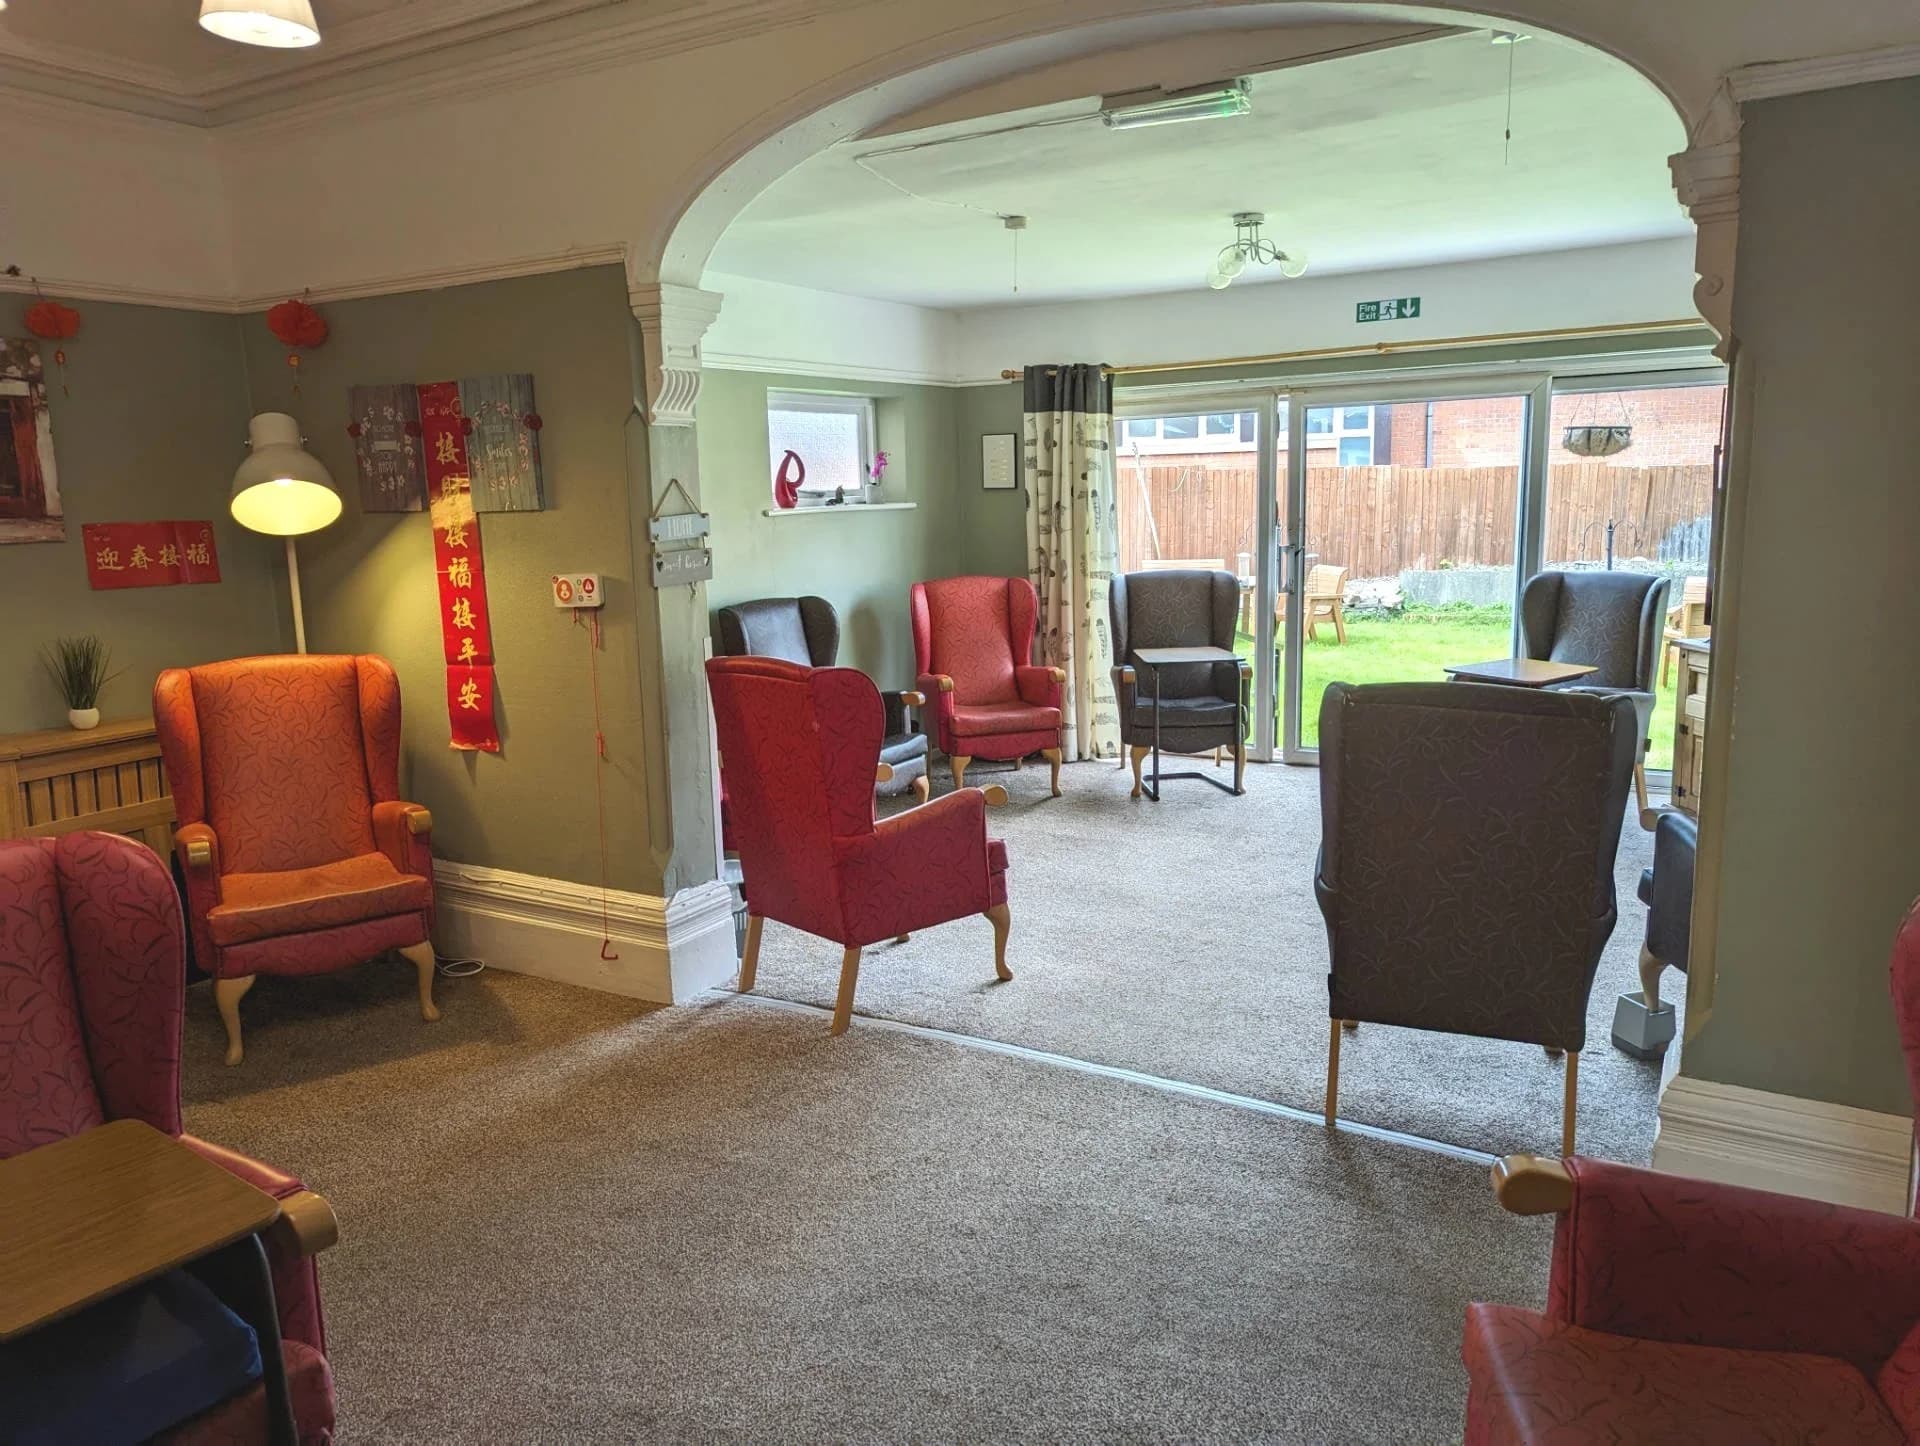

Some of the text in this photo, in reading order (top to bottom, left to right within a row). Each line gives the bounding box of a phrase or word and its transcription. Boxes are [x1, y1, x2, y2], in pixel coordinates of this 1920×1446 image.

[1360, 304, 1377, 312] Fire
[1359, 312, 1376, 321] Exit
[96, 543, 211, 570] 迎春接福
